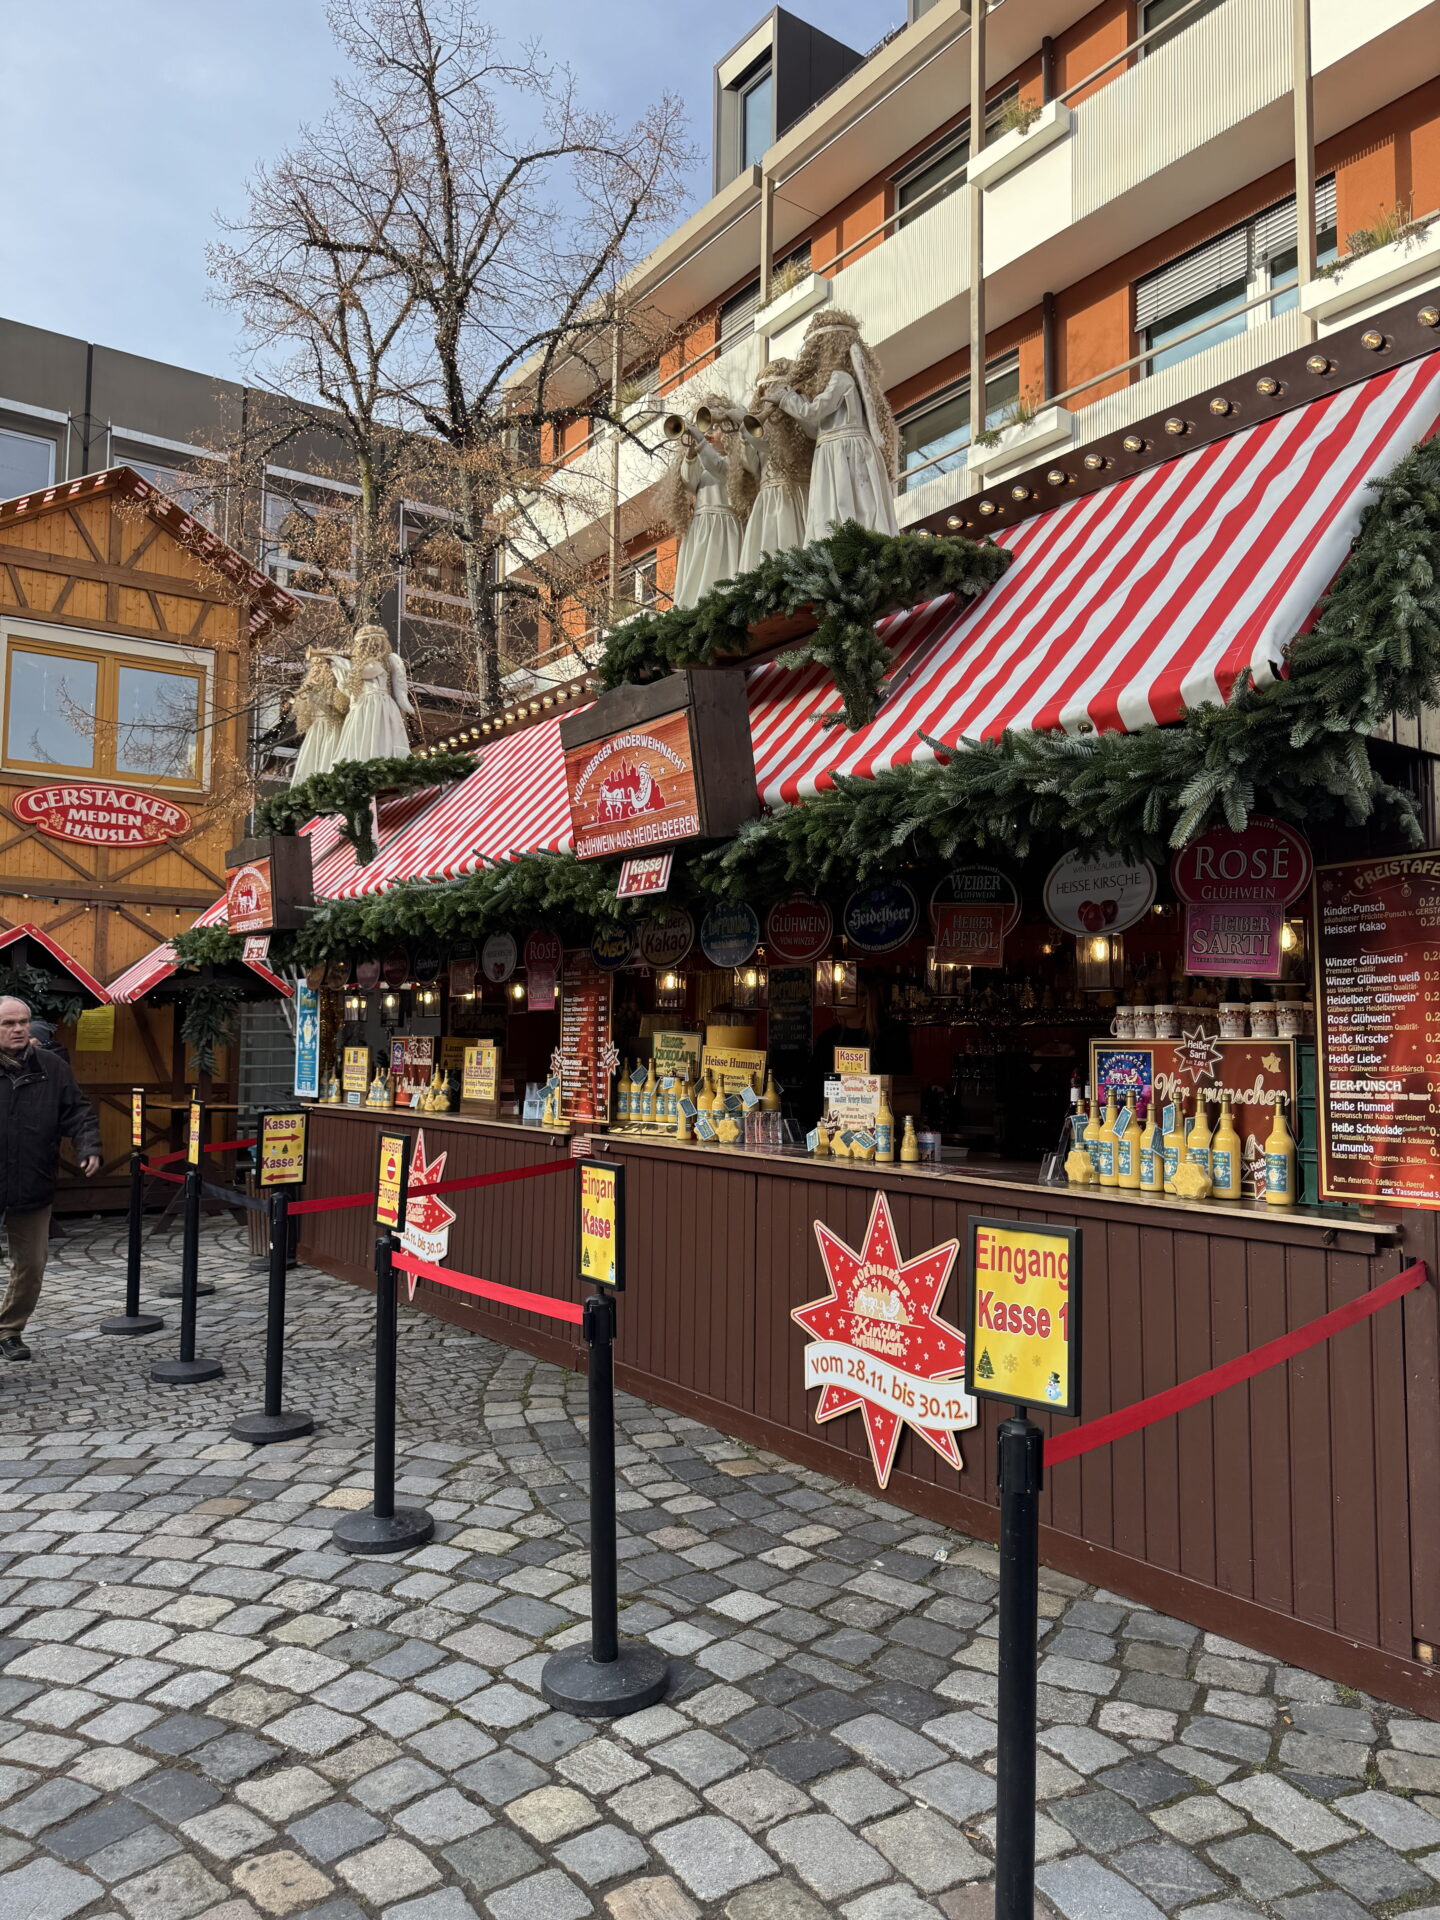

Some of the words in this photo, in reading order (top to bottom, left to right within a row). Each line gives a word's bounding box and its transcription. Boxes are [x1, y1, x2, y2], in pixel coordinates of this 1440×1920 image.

[573, 744, 613, 804] NÜRNBERGER
[613, 734, 687, 773] KINDERWEIHNACHT
[28, 788, 180, 826] GERSTACKER
[67, 808, 142, 827] MEDIEN
[64, 821, 143, 841] HÄUSLA
[1249, 819, 1279, 832] UALITÄT
[576, 836, 616, 858] GLÜHWEIN
[616, 831, 632, 848] AUS
[633, 814, 698, 845] HEIDELBEEREN
[630, 857, 662, 875] Kasse
[1192, 838, 1290, 880] ROSÉ
[1057, 879, 1091, 894] HEISSE
[1093, 872, 1142, 890] KIRSCHE
[1201, 884, 1276, 900] GLÜHWEIN
[1323, 902, 1385, 916] Kinder-Punsch
[771, 911, 827, 933] GLÜHWEIN
[1324, 924, 1357, 935] Heisser
[1359, 922, 1387, 932] Kakao
[645, 932, 687, 954] Kakao
[940, 928, 999, 949] APEROL
[1192, 929, 1272, 956] SARTI
[1325, 957, 1357, 967] Winzer
[1359, 954, 1404, 965] Glühwein
[1325, 976, 1355, 986] Winzer
[1357, 973, 1397, 984] Glühwein
[1399, 971, 1421, 982] weiß
[1326, 995, 1373, 1005] Heidelbeer
[1375, 993, 1416, 1003] Glühwein
[1327, 1014, 1349, 1024] Rosé
[1351, 1013, 1391, 1024] Glühwein
[1187, 1040, 1210, 1050] Heißer
[1328, 1034, 1353, 1044] Heiße
[1355, 1033, 1389, 1044] Kirsche
[840, 1051, 864, 1061] Kasse
[1189, 1051, 1207, 1059] Sarti
[1329, 1053, 1355, 1063] Heiße
[1357, 1053, 1382, 1063] Liebe
[705, 1056, 728, 1067] Heisse
[730, 1057, 762, 1070] Hummel
[1154, 1072, 1190, 1101] Wir
[1329, 1080, 1402, 1091] EIER-PUNSCH
[1330, 1101, 1355, 1111] Heiße
[1357, 1102, 1394, 1112] Hummel
[264, 1118, 296, 1130] Kasse
[300, 1116, 304, 1128] 1
[1331, 1112, 1363, 1120] Eierpunsch
[1331, 1122, 1354, 1133] Heiße
[1356, 1123, 1403, 1135] Schokolade
[1332, 1142, 1374, 1153] Lumumba
[262, 1157, 294, 1169] Kasse
[297, 1154, 303, 1166] 2
[581, 1170, 616, 1204] Eingan
[583, 1208, 611, 1239] Kasse
[976, 1233, 1068, 1291] Eingang
[978, 1289, 1051, 1338] Kasse
[1058, 1302, 1068, 1341] 1
[854, 1315, 905, 1343] Kinder
[811, 1355, 844, 1374] vom
[847, 1359, 887, 1395] 28.11.
[891, 1375, 915, 1408] bis
[918, 1394, 969, 1420] 30.12.
